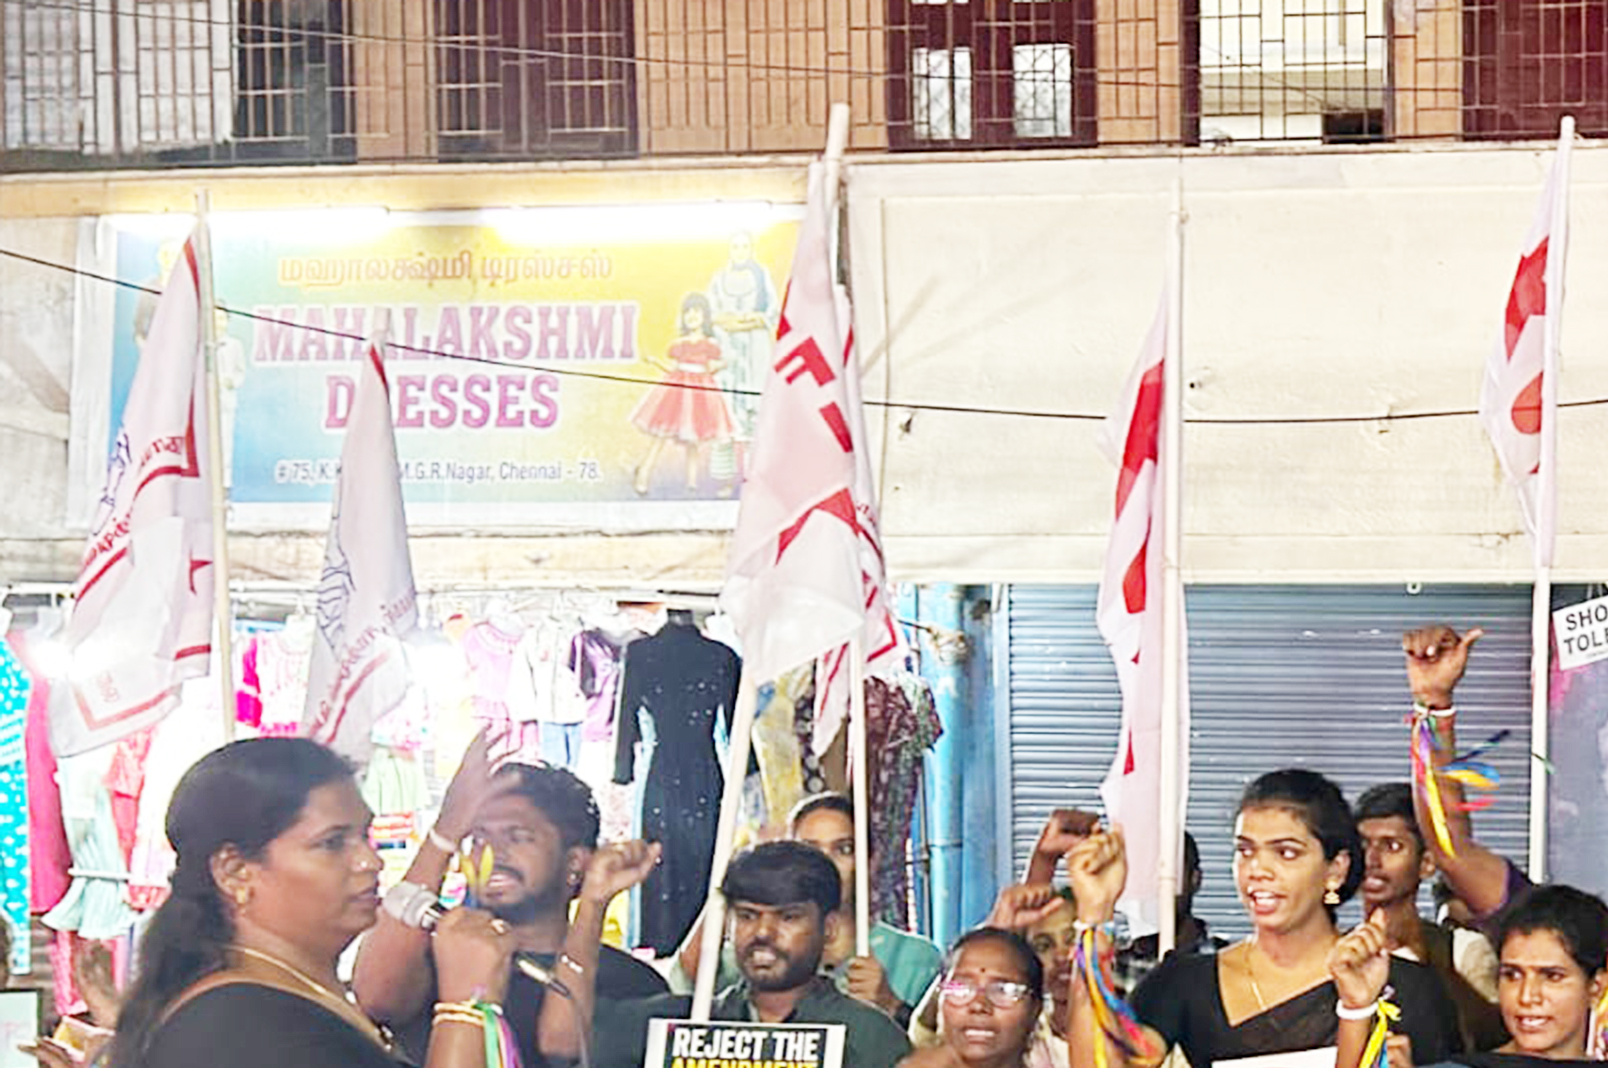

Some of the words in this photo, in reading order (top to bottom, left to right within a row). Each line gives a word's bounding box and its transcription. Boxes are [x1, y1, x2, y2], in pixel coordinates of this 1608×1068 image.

[325, 374, 560, 430] DESSES
[500, 461, 562, 480] Chennai
[671, 1027, 768, 1060] REJECT
[772, 1032, 821, 1061] THE
